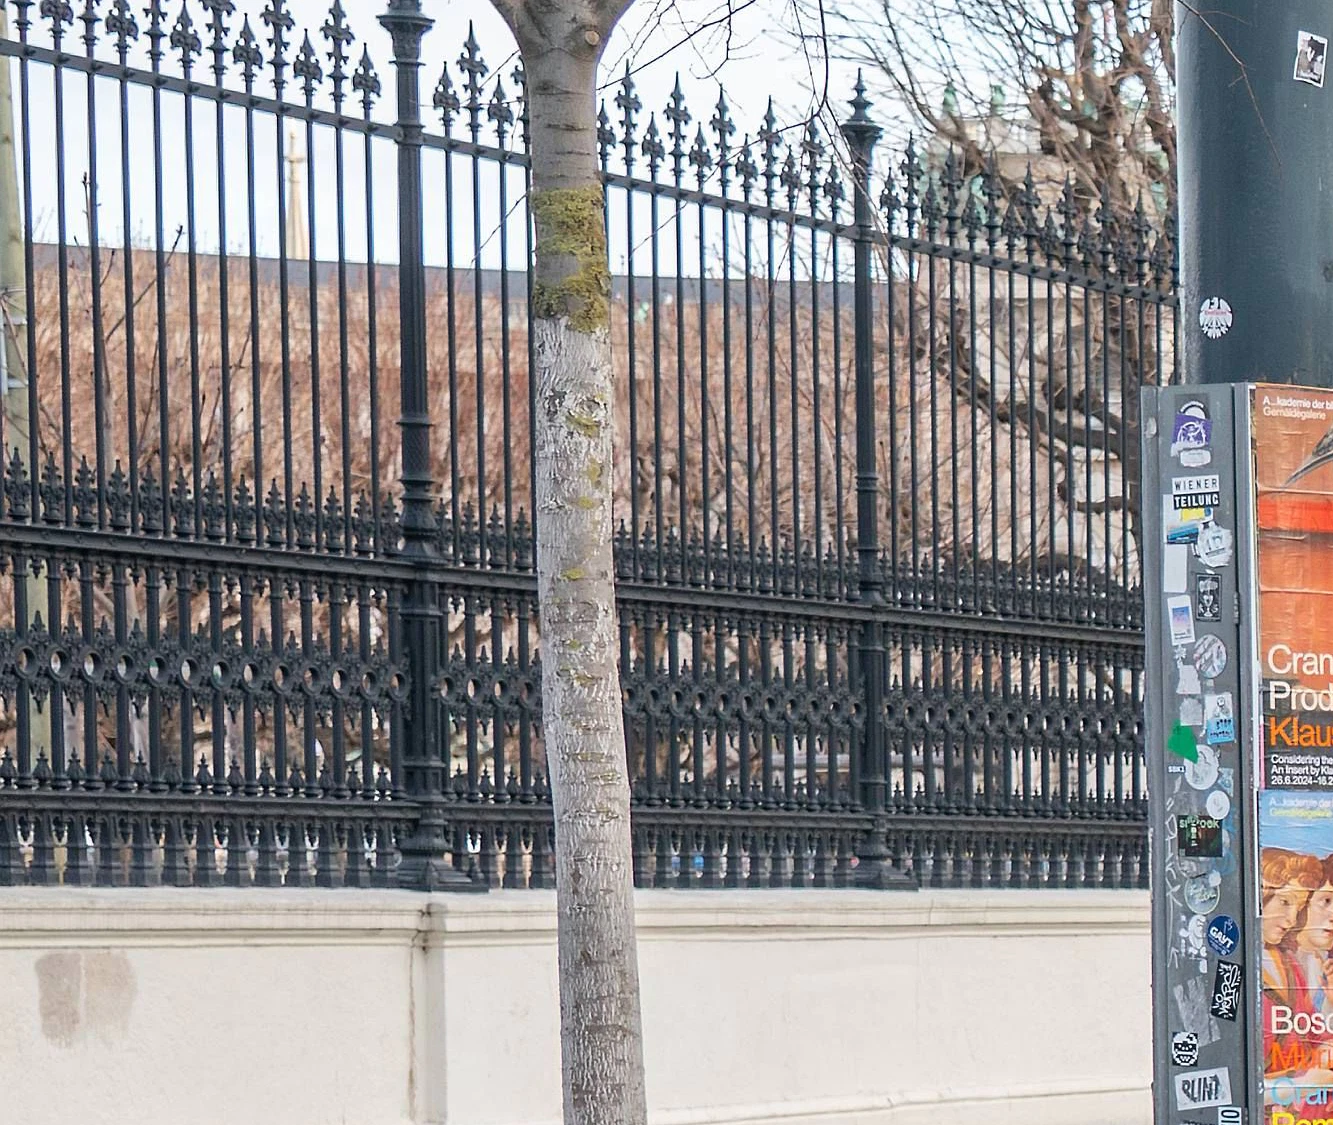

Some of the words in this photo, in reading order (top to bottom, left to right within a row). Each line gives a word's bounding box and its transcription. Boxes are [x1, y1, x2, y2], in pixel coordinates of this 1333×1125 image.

[1174, 478, 1218, 491] WIENER
[1174, 494, 1219, 508] TEILUNG
[1271, 754, 1320, 766] Considering
[1321, 755, 1333, 765] the
[1271, 765, 1285, 774] An
[1285, 765, 1309, 775] Insert
[1310, 766, 1320, 776] by
